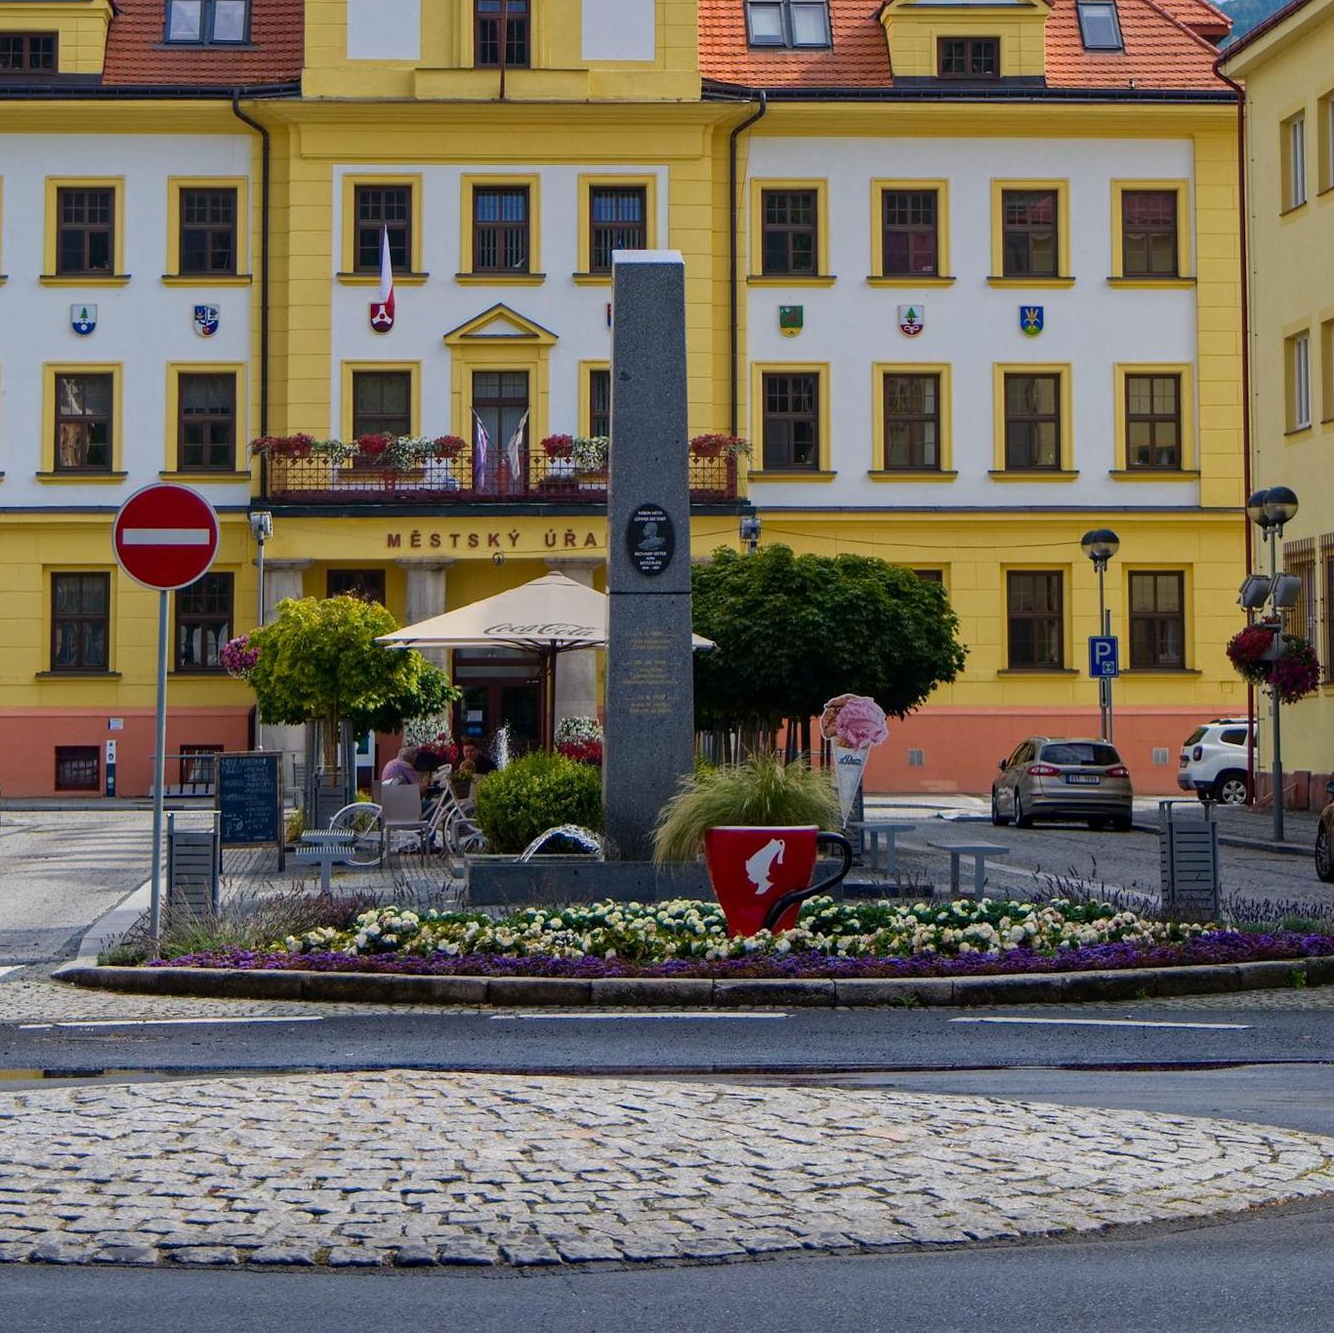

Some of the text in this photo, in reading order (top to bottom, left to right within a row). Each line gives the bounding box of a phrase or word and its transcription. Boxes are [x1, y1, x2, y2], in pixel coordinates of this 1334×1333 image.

[387, 529, 608, 548] MĚSTSKÝ ÚŘA
[1095, 642, 1112, 665] P
